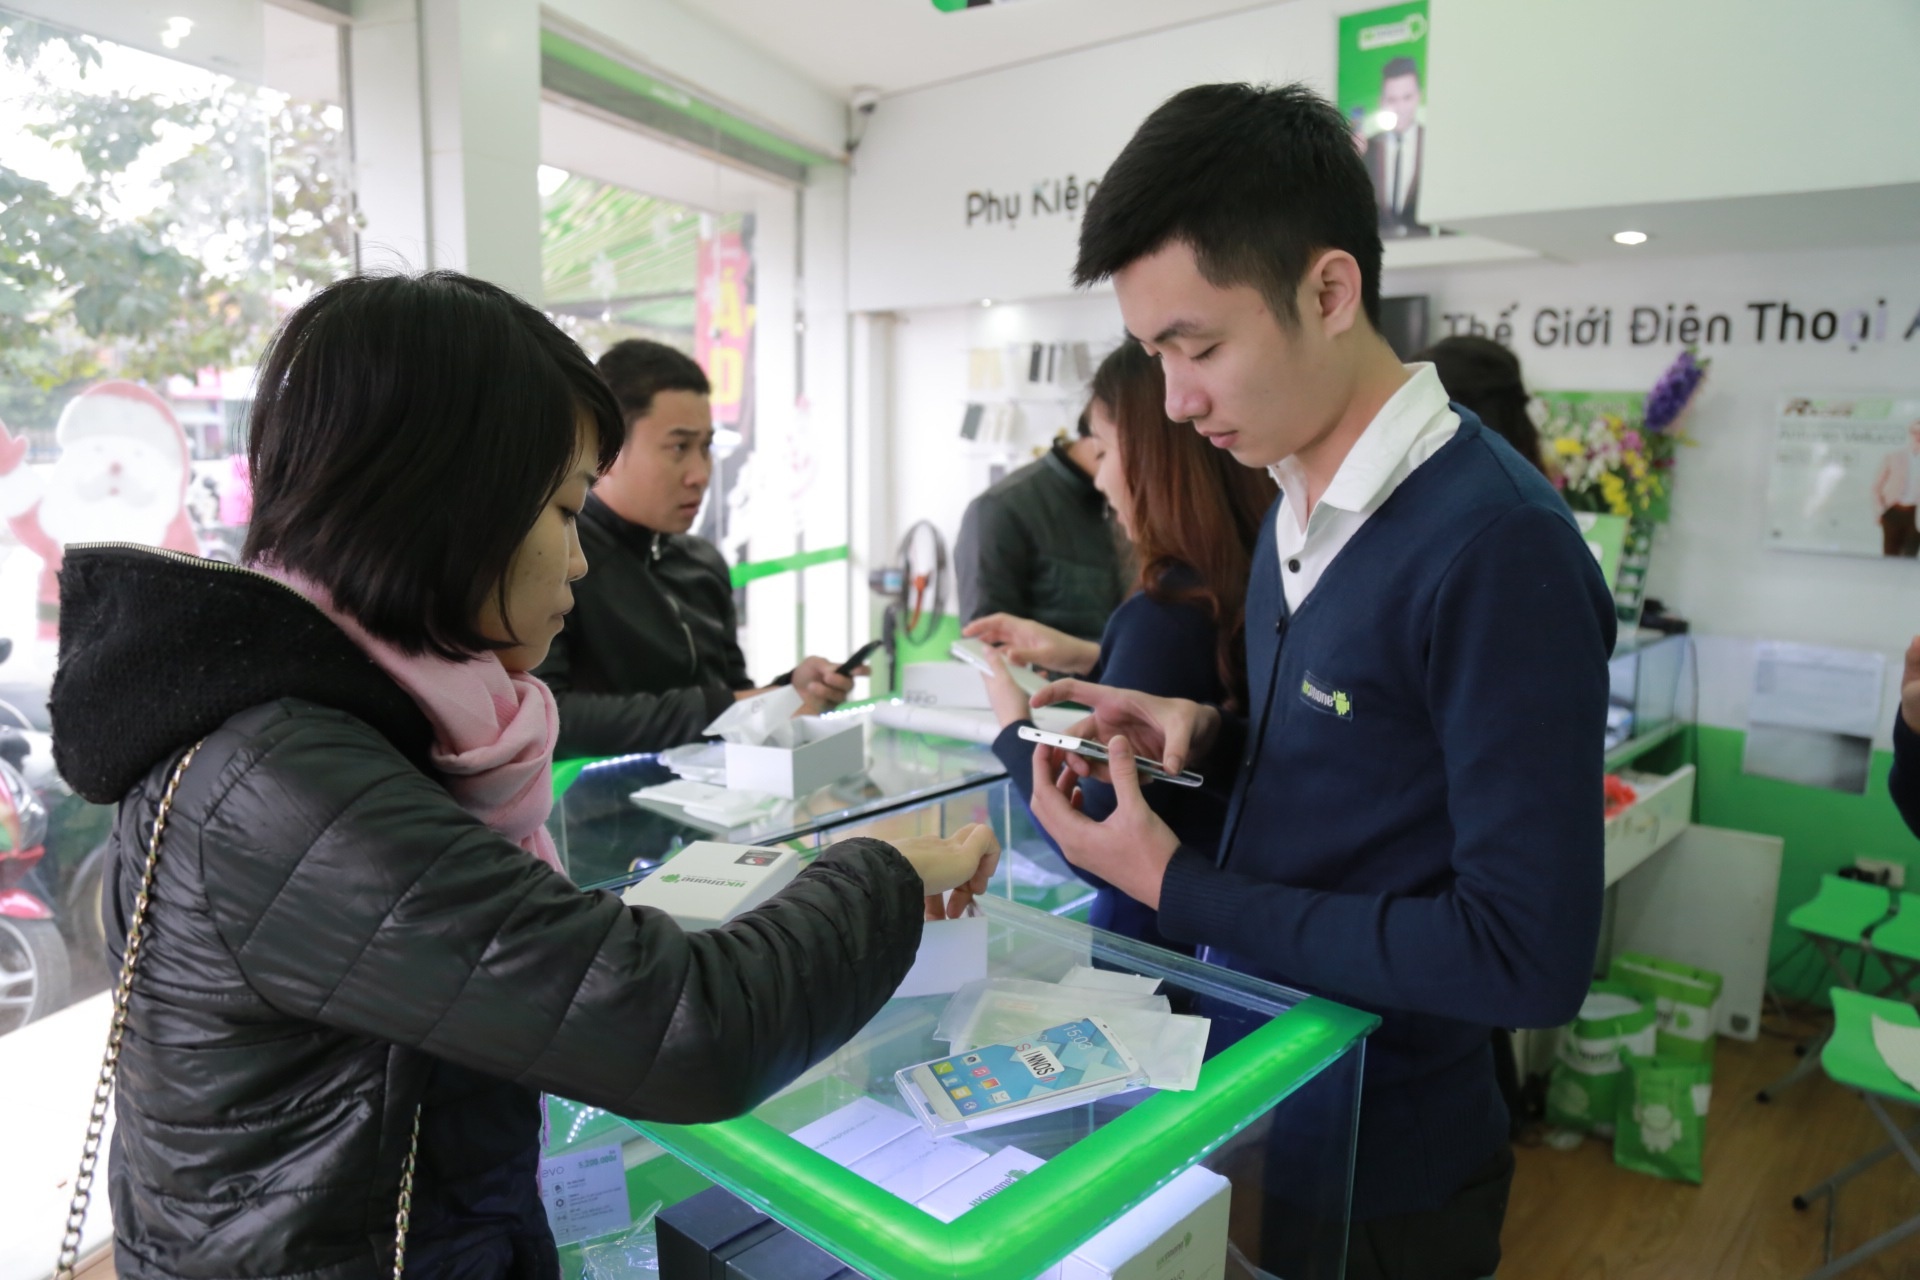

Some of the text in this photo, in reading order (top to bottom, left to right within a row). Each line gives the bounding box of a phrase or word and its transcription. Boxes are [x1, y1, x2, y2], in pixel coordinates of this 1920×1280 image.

[966, 189, 1021, 229] Phụ
[1533, 307, 1611, 347] Giới
[1747, 298, 1887, 352] Thoại
[1063, 1024, 1093, 1051] 15:03
